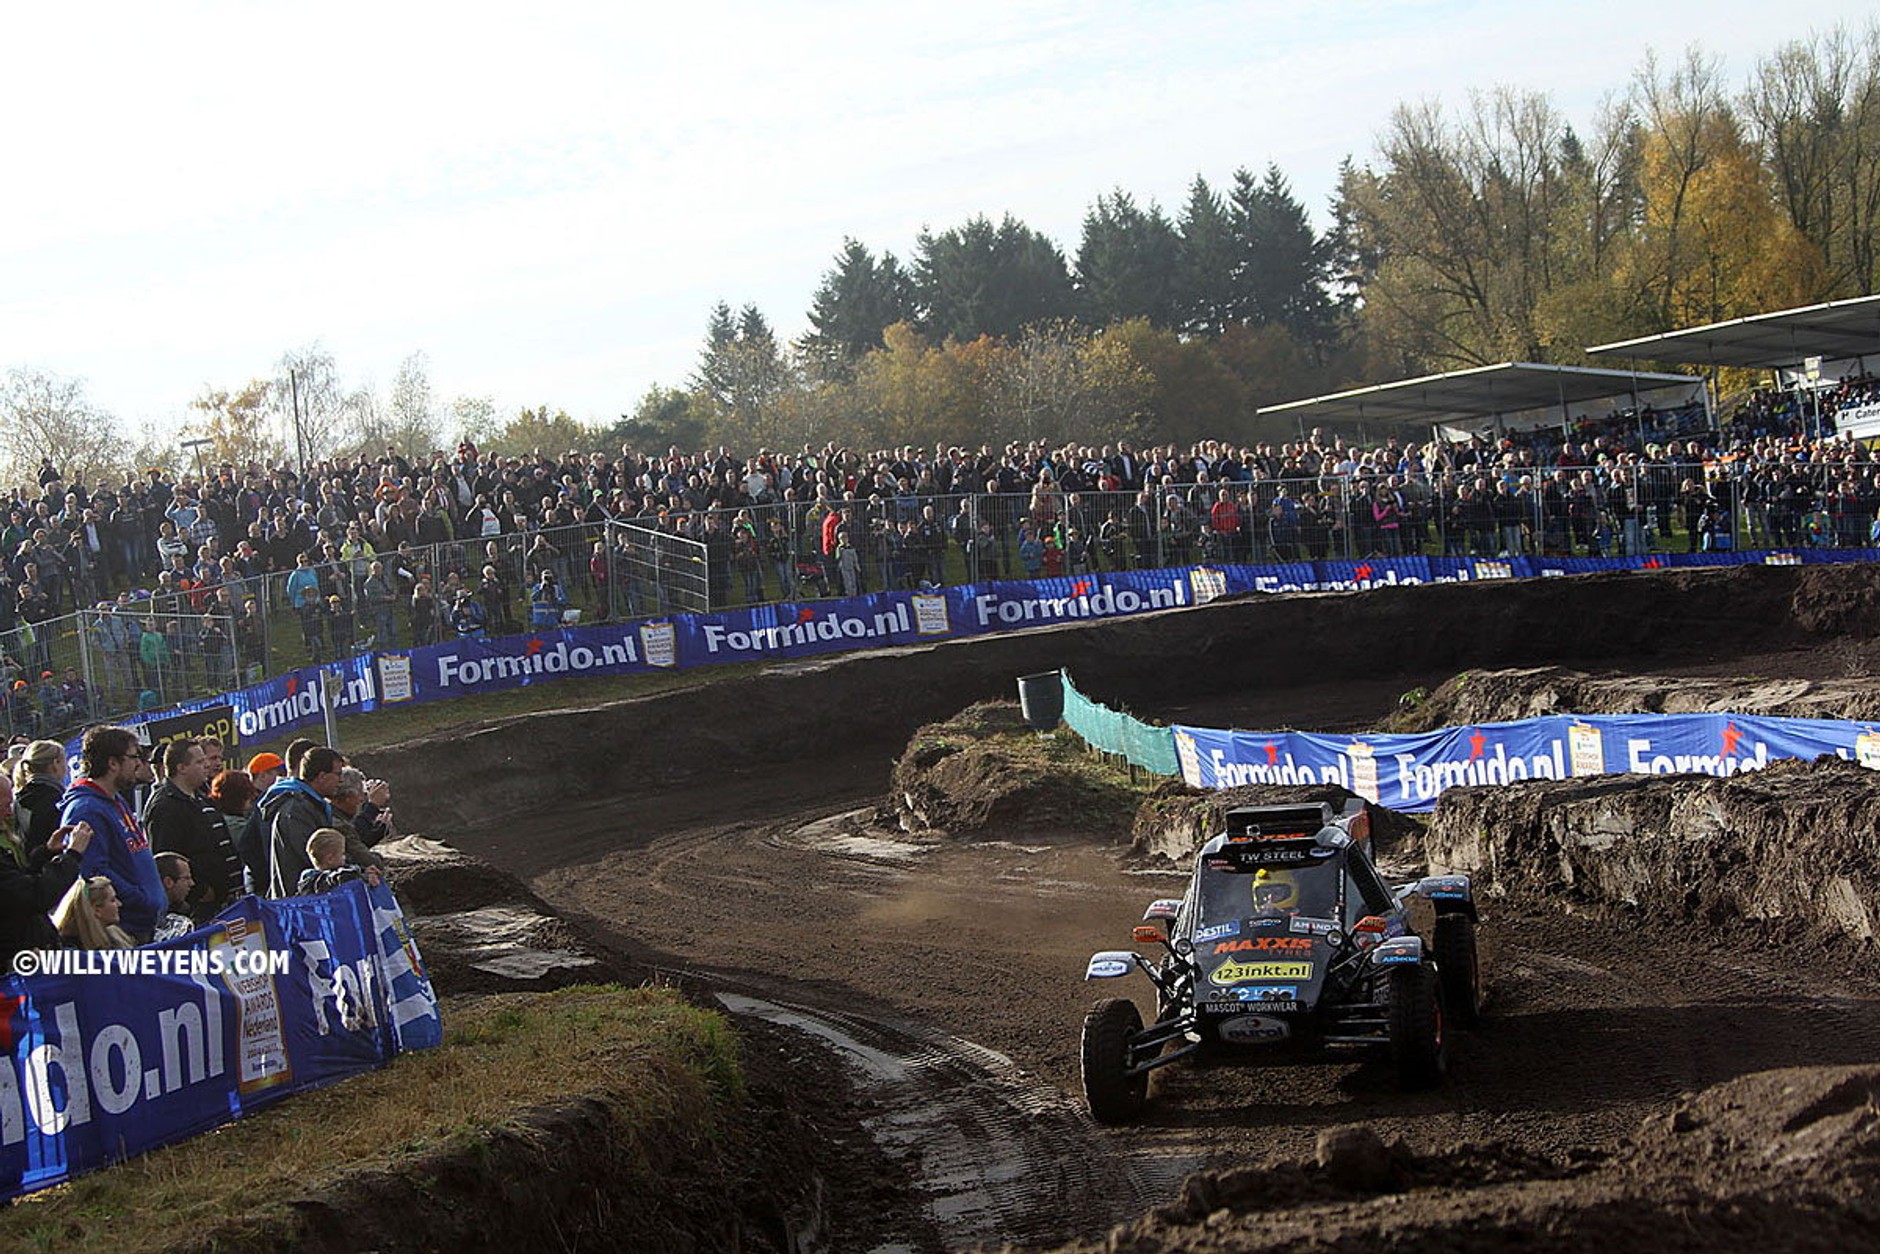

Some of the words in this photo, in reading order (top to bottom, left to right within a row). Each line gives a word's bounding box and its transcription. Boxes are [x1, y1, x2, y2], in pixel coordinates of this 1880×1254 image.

[976, 579, 1186, 626] Formido.nl
[703, 603, 910, 652] Formido.nl
[438, 635, 638, 687] Formido.nl
[233, 667, 375, 737] ormid.nl
[1211, 745, 1349, 791] Formidonl
[1394, 735, 1566, 799] Formidonl
[1240, 853, 1260, 862] TW
[1263, 850, 1305, 860] STEEL
[1196, 923, 1232, 939] DESTIL
[1213, 937, 1313, 955] MAXXIS
[1217, 963, 1307, 980] 123inkt.nl
[1247, 1001, 1298, 1013] WORKWEAR
